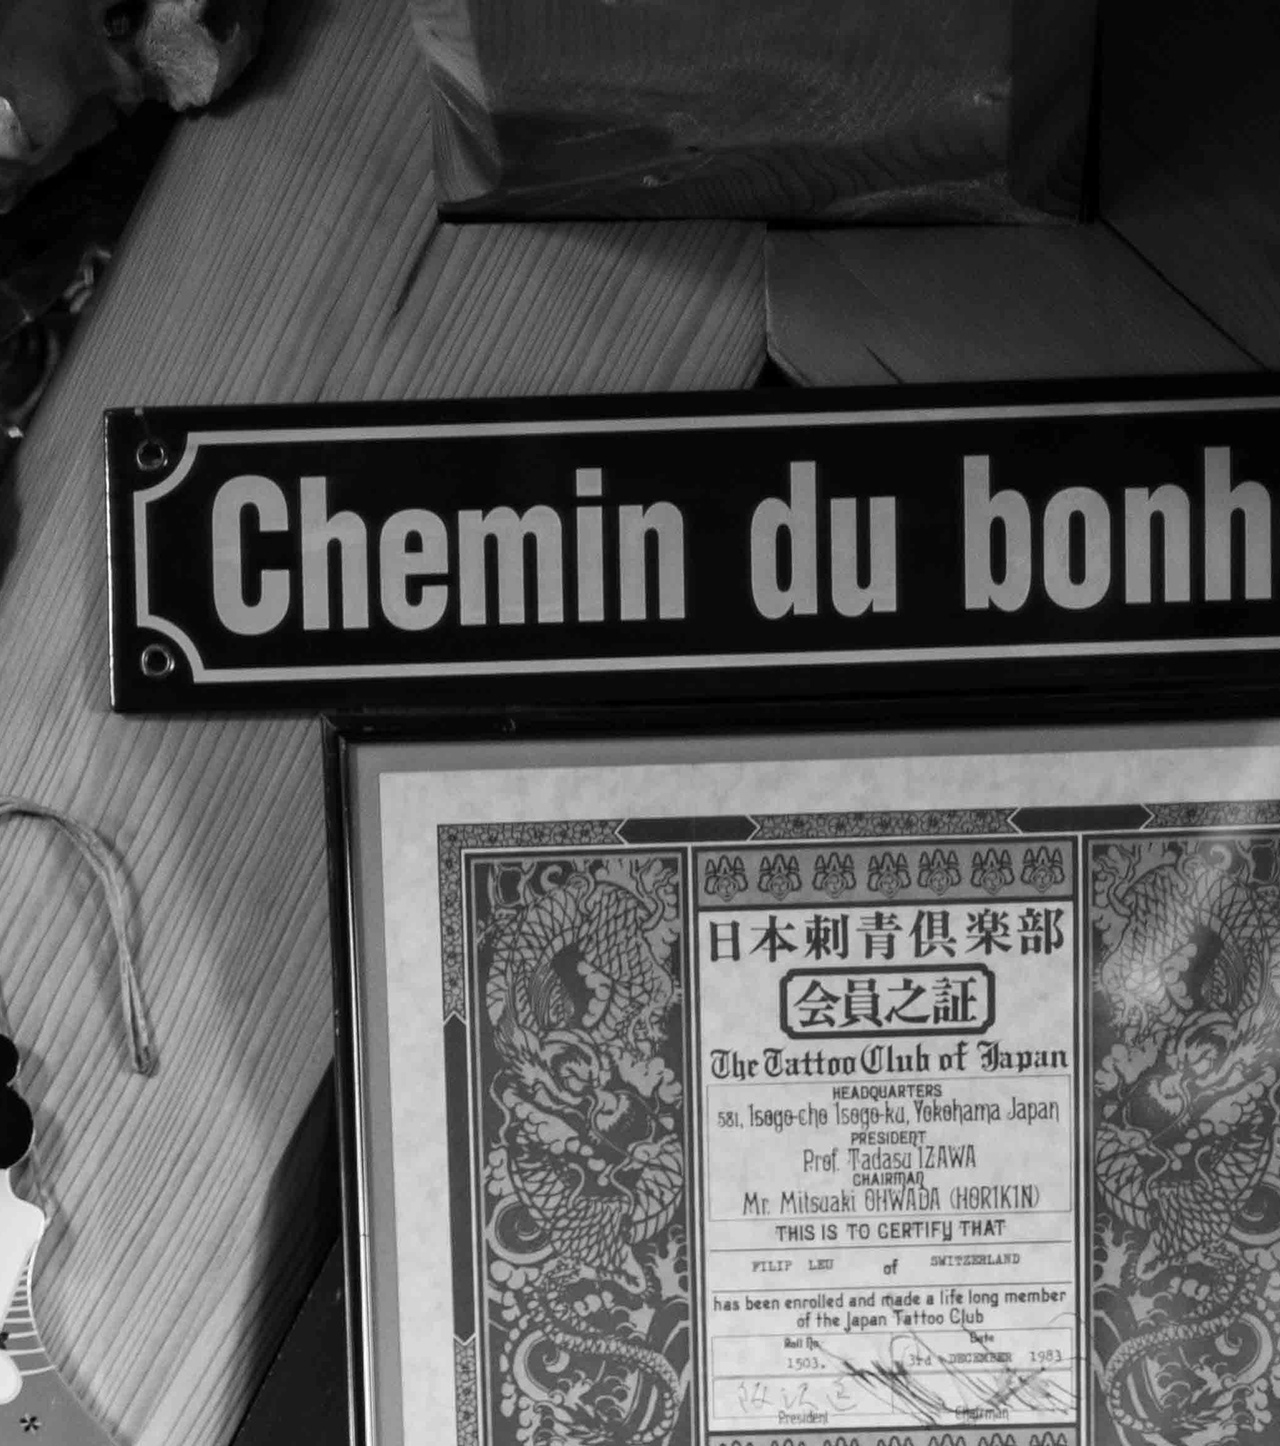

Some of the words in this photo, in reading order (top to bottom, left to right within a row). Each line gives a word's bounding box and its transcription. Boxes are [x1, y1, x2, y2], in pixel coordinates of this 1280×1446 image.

[210, 467, 688, 637] Chemin
[748, 460, 898, 621] du
[793, 975, 978, 1028] 会員之証
[711, 1048, 759, 1081] The
[763, 1047, 856, 1078] Tattoo
[860, 1042, 933, 1075] Club
[939, 1040, 968, 1072] of
[977, 1041, 1069, 1073] Japan
[832, 1084, 942, 1101] HEADQUARTERS
[914, 1098, 1000, 1125] Yokohama
[1007, 1097, 1060, 1125] Japan
[851, 1130, 926, 1148] PRESIDENT
[803, 1149, 840, 1173] Prof.
[848, 1147, 912, 1171] Tadasu
[853, 1171, 925, 1190] CHAIRMAN
[743, 1192, 769, 1216] Mr.
[780, 1190, 856, 1215] Mitsuaki
[865, 1187, 940, 1212] OHWADA
[775, 1224, 815, 1242] THIS
[821, 1223, 837, 1241] IS
[846, 1223, 870, 1241] TO
[878, 1221, 952, 1242] CERTIFY
[959, 1219, 1007, 1237] THAT
[752, 1260, 792, 1273] FILIP
[807, 1259, 834, 1271] LEU
[883, 1258, 898, 1276] of
[930, 1253, 1020, 1267] SWITZERLAND
[713, 1295, 740, 1312] has
[745, 1294, 780, 1311] been
[784, 1291, 844, 1310] enrolled
[848, 1290, 875, 1307] and
[880, 1289, 921, 1307] made
[925, 1294, 934, 1306] a
[939, 1287, 963, 1306] life
[968, 1287, 999, 1308] long
[1004, 1287, 1066, 1304] member
[797, 1312, 812, 1329] of
[815, 1312, 840, 1328] the
[844, 1311, 887, 1334] Japan
[892, 1309, 944, 1327] Tattoo
[950, 1307, 984, 1326] Club
[1030, 1350, 1062, 1364] 1983
[778, 1409, 828, 1426] President
